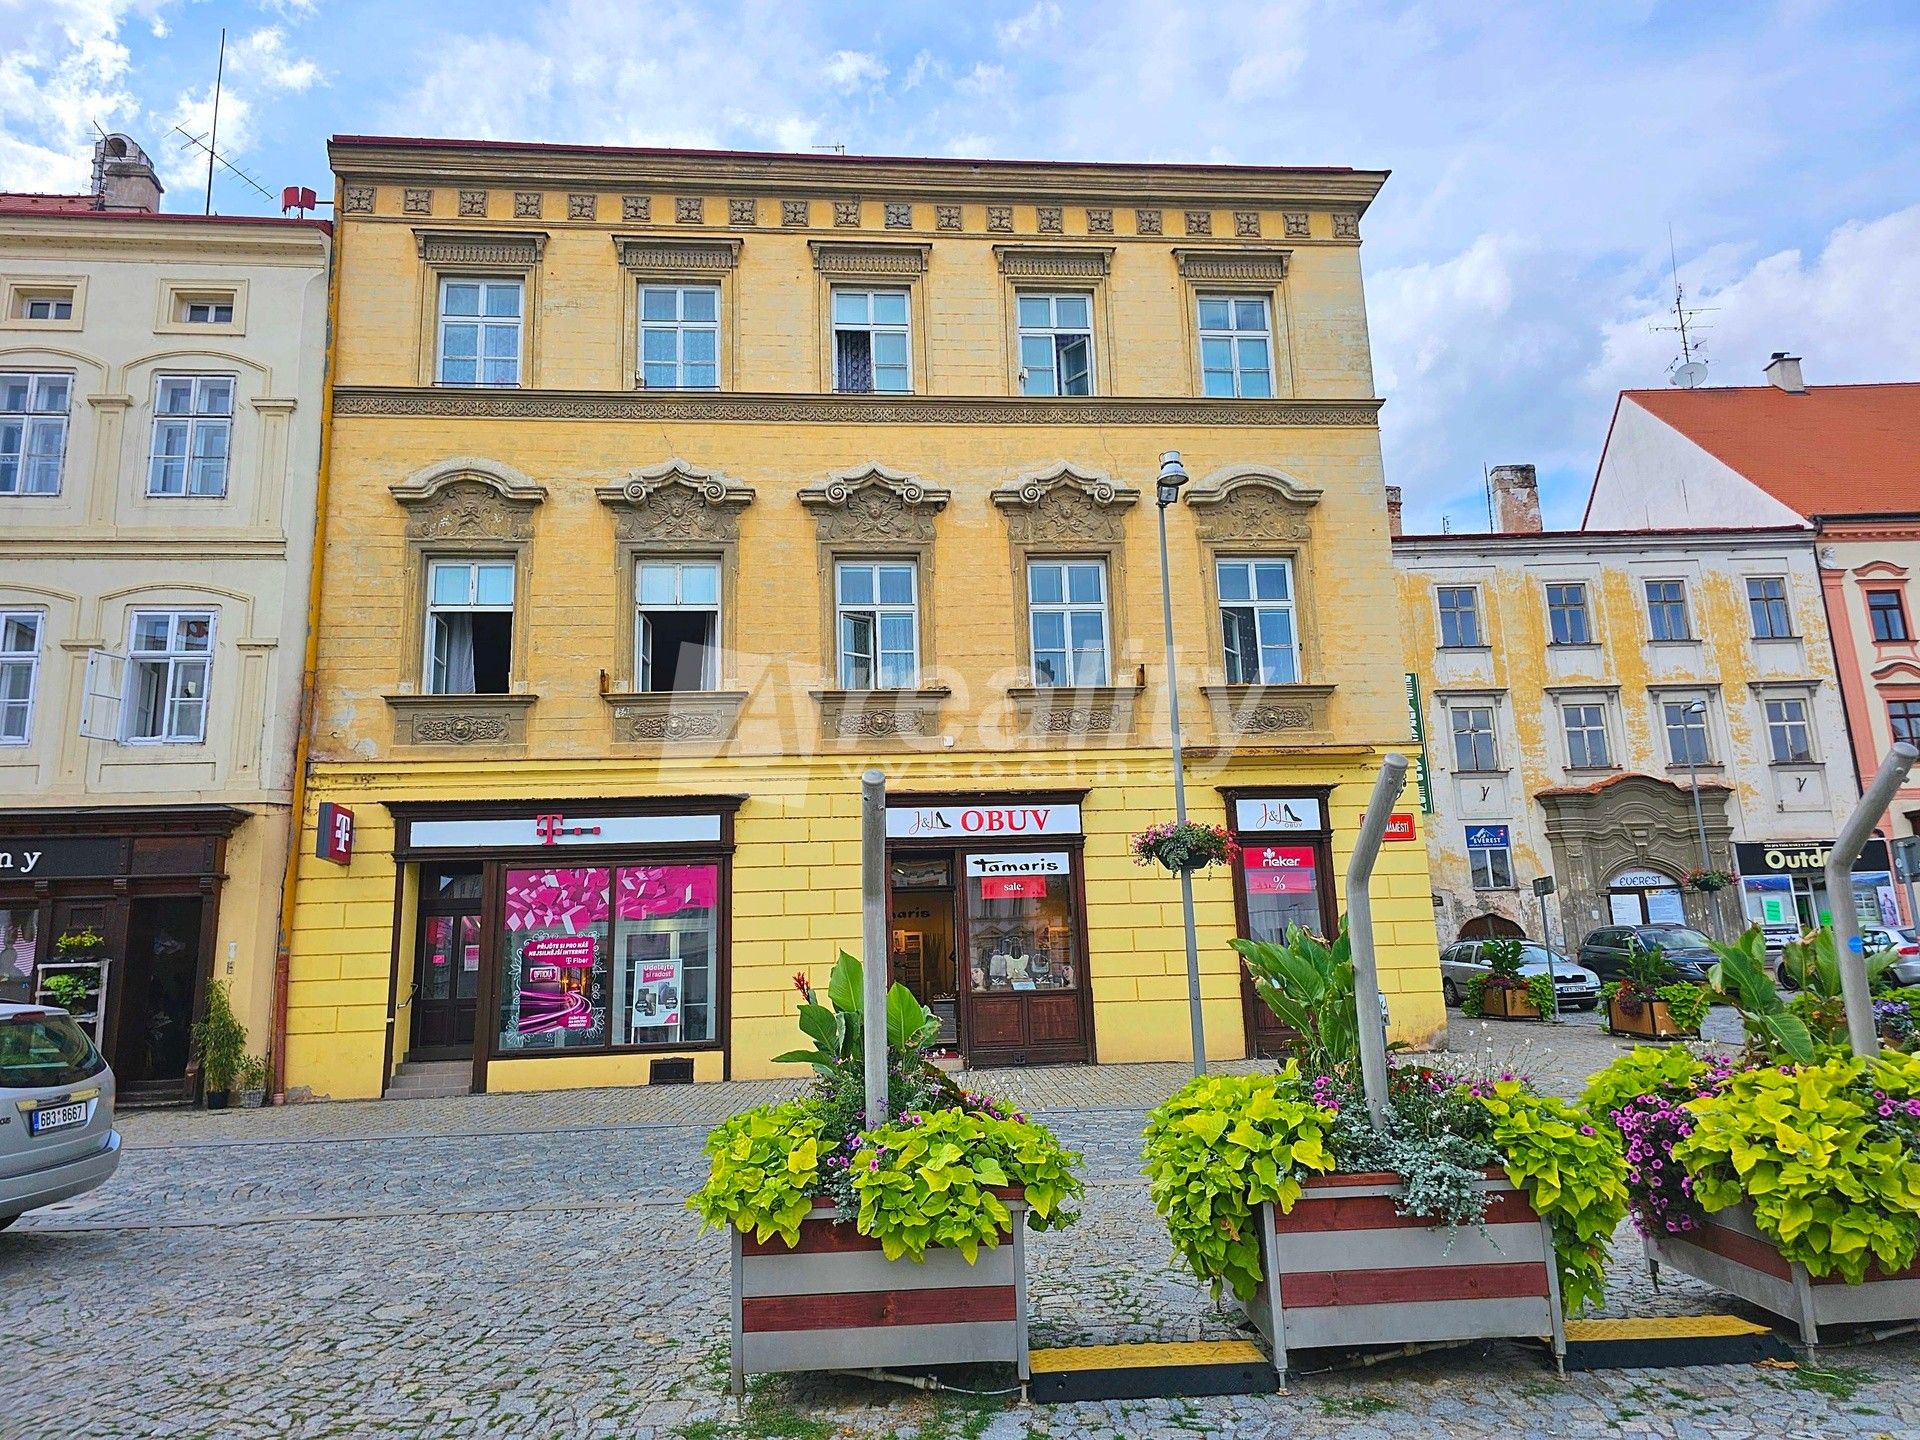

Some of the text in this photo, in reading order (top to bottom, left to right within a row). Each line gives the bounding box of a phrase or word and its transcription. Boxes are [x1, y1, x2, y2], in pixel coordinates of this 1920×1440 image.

[961, 809, 1050, 832] OBUV
[1262, 855, 1301, 867] rieker
[1765, 847, 1861, 869] Outd
[1003, 882, 1024, 892] sale.
[40, 1105, 82, 1128] 6B3 8667
